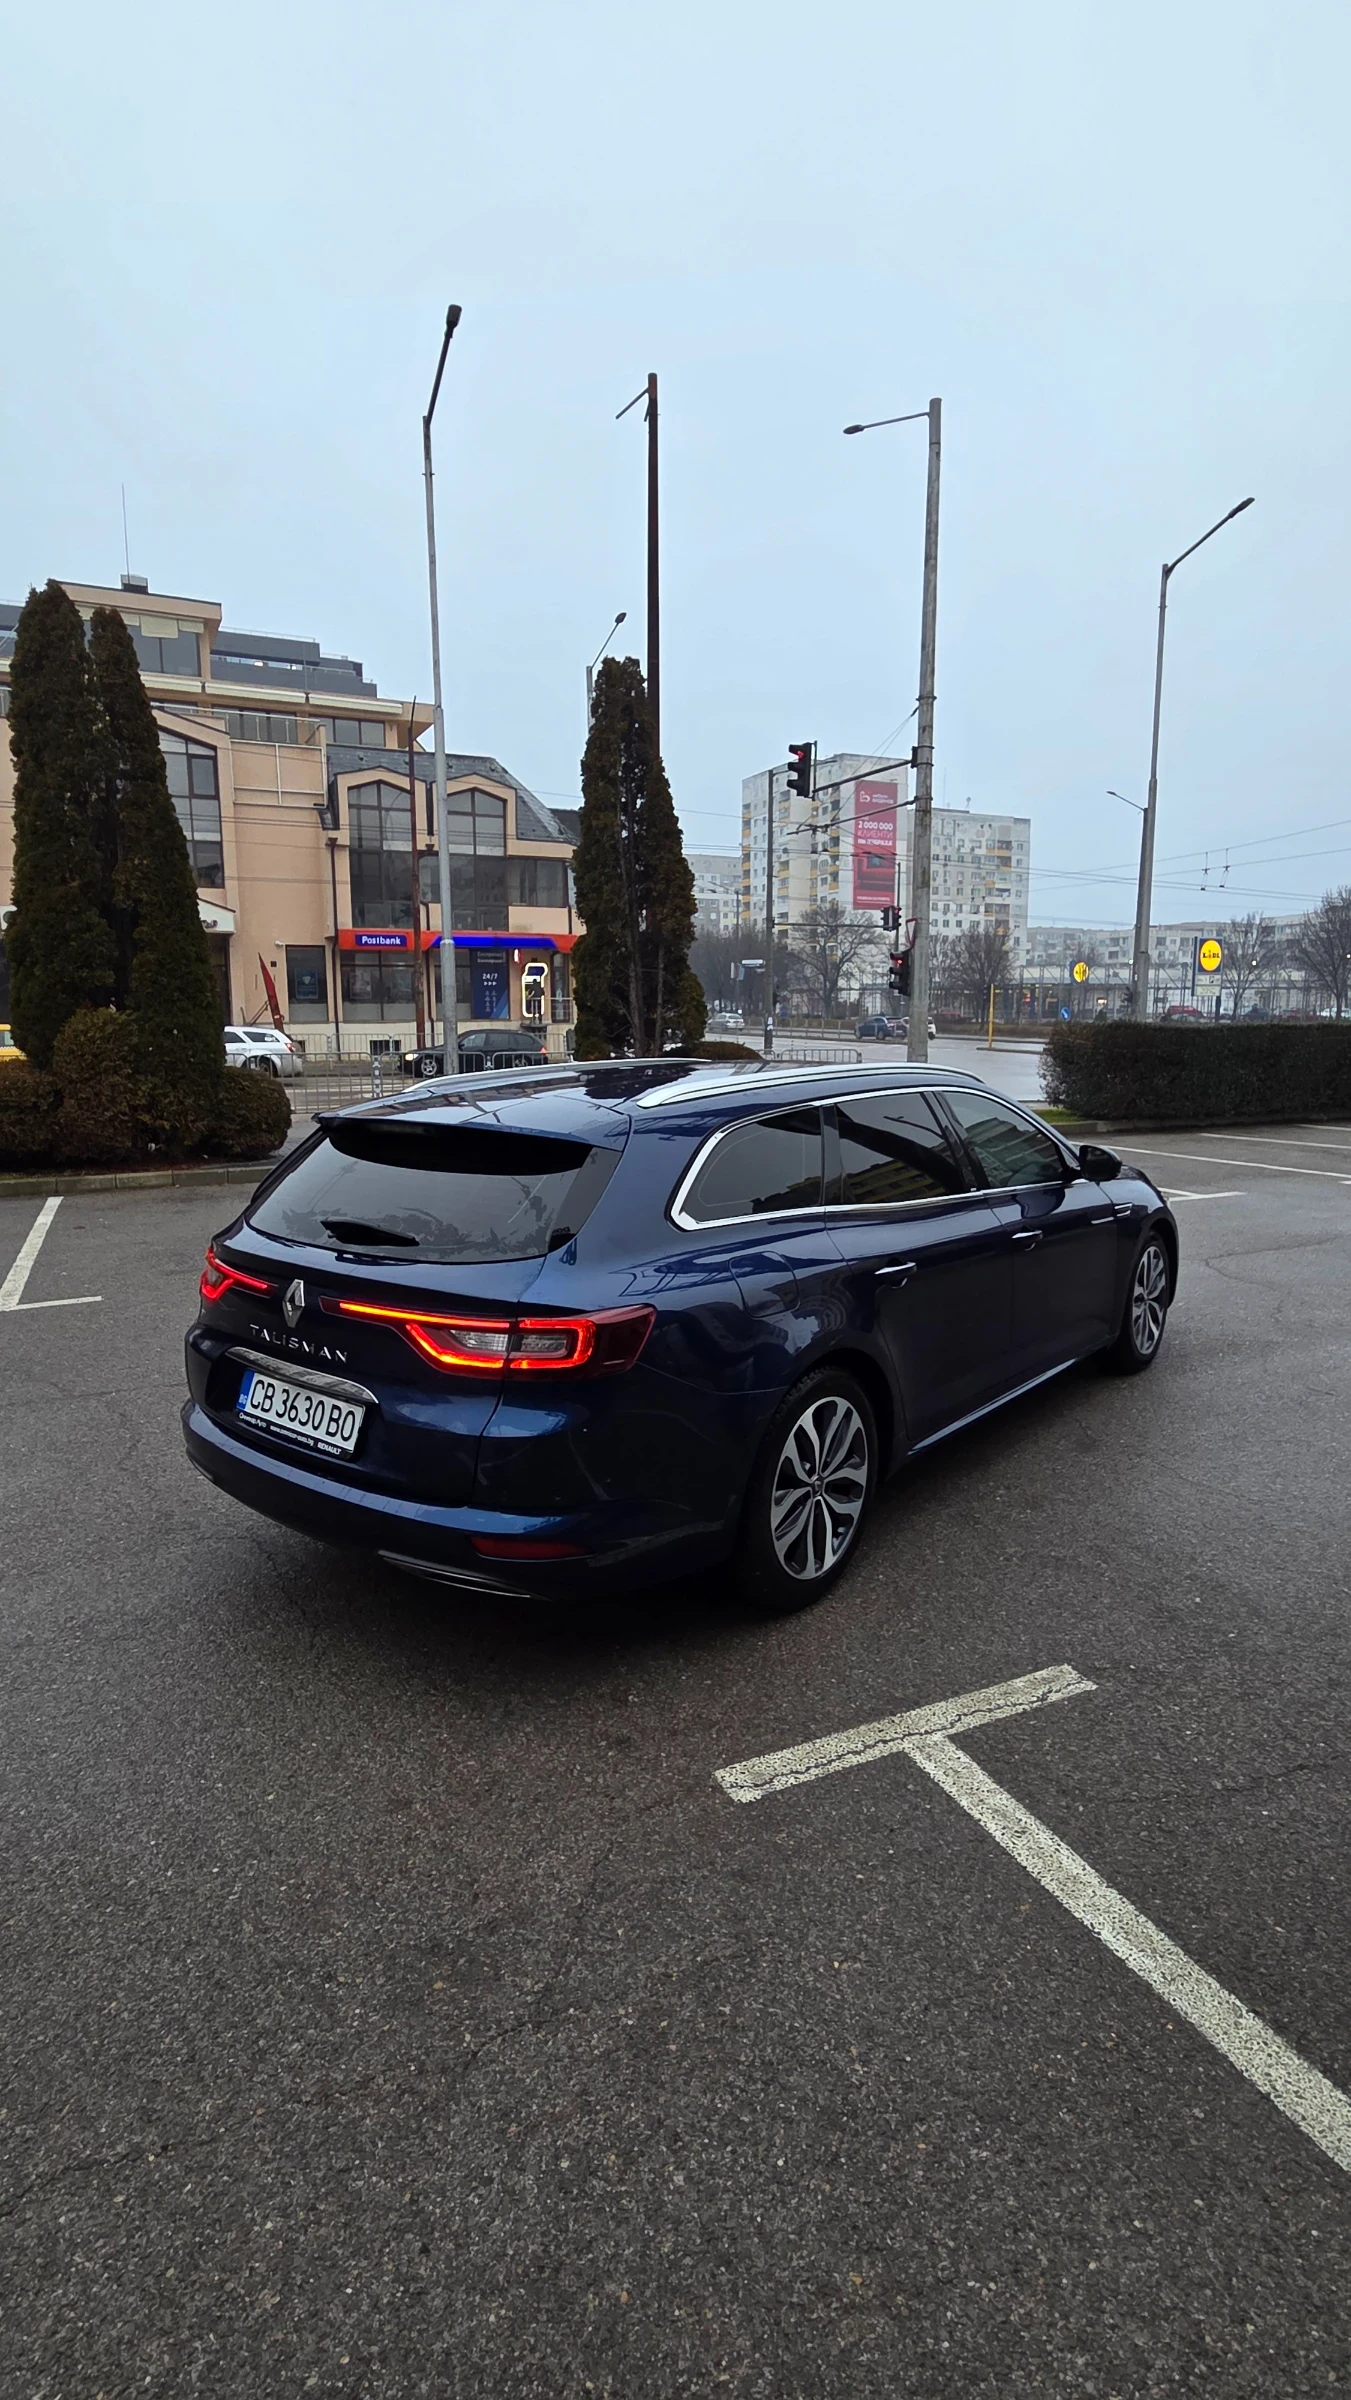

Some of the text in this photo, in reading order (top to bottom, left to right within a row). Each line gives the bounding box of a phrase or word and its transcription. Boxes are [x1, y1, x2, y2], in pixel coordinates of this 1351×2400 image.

[362, 935, 401, 945] Postbank
[250, 1324, 347, 1363] TALISMAN
[239, 1393, 248, 1405] BG
